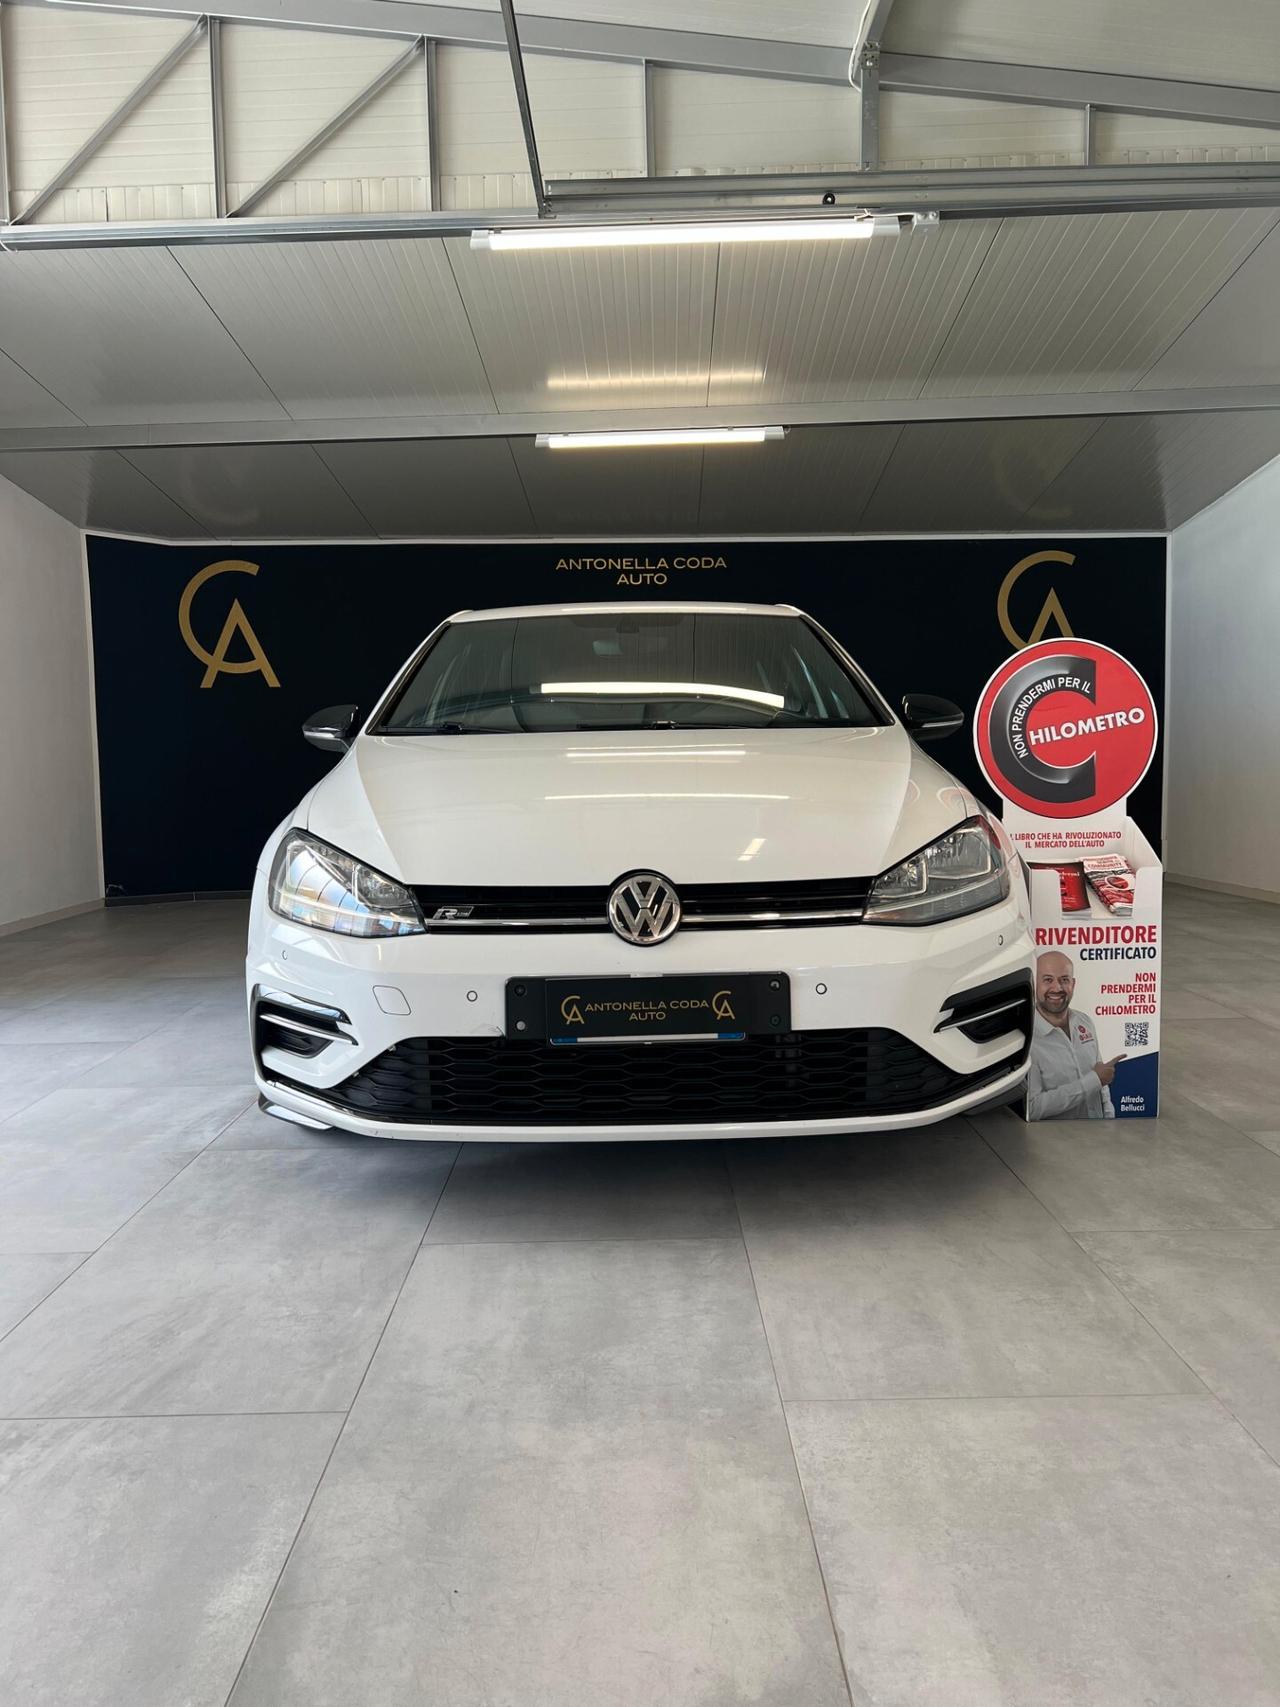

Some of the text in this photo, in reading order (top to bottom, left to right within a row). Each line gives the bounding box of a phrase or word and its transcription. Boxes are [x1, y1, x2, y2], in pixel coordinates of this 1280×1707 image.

[555, 557, 727, 570] ANTONELLA CODA
[616, 573, 668, 585] AUTO
[1012, 676, 1091, 759] NON PRENDERMI PER IL
[1015, 832, 1036, 841] LIBRO
[1037, 832, 1051, 840] CHE
[1052, 832, 1063, 840] HA
[1065, 831, 1122, 840] RIVOLUZIONATO
[1034, 840, 1068, 848] MERCATO
[1069, 840, 1105, 848] DELL'AUTO
[1035, 925, 1157, 946] RIVENDITORE
[1080, 946, 1157, 961] CERTIFICATO
[1135, 972, 1156, 982] NON
[1101, 983, 1156, 994] PRENDERMI
[1128, 994, 1156, 1004] PER IL
[584, 1001, 667, 1013] ANTONELLA
[669, 1000, 710, 1009] CODA
[1095, 1004, 1156, 1015] CHILOMETRO
[629, 1012, 667, 1021] AUTO
